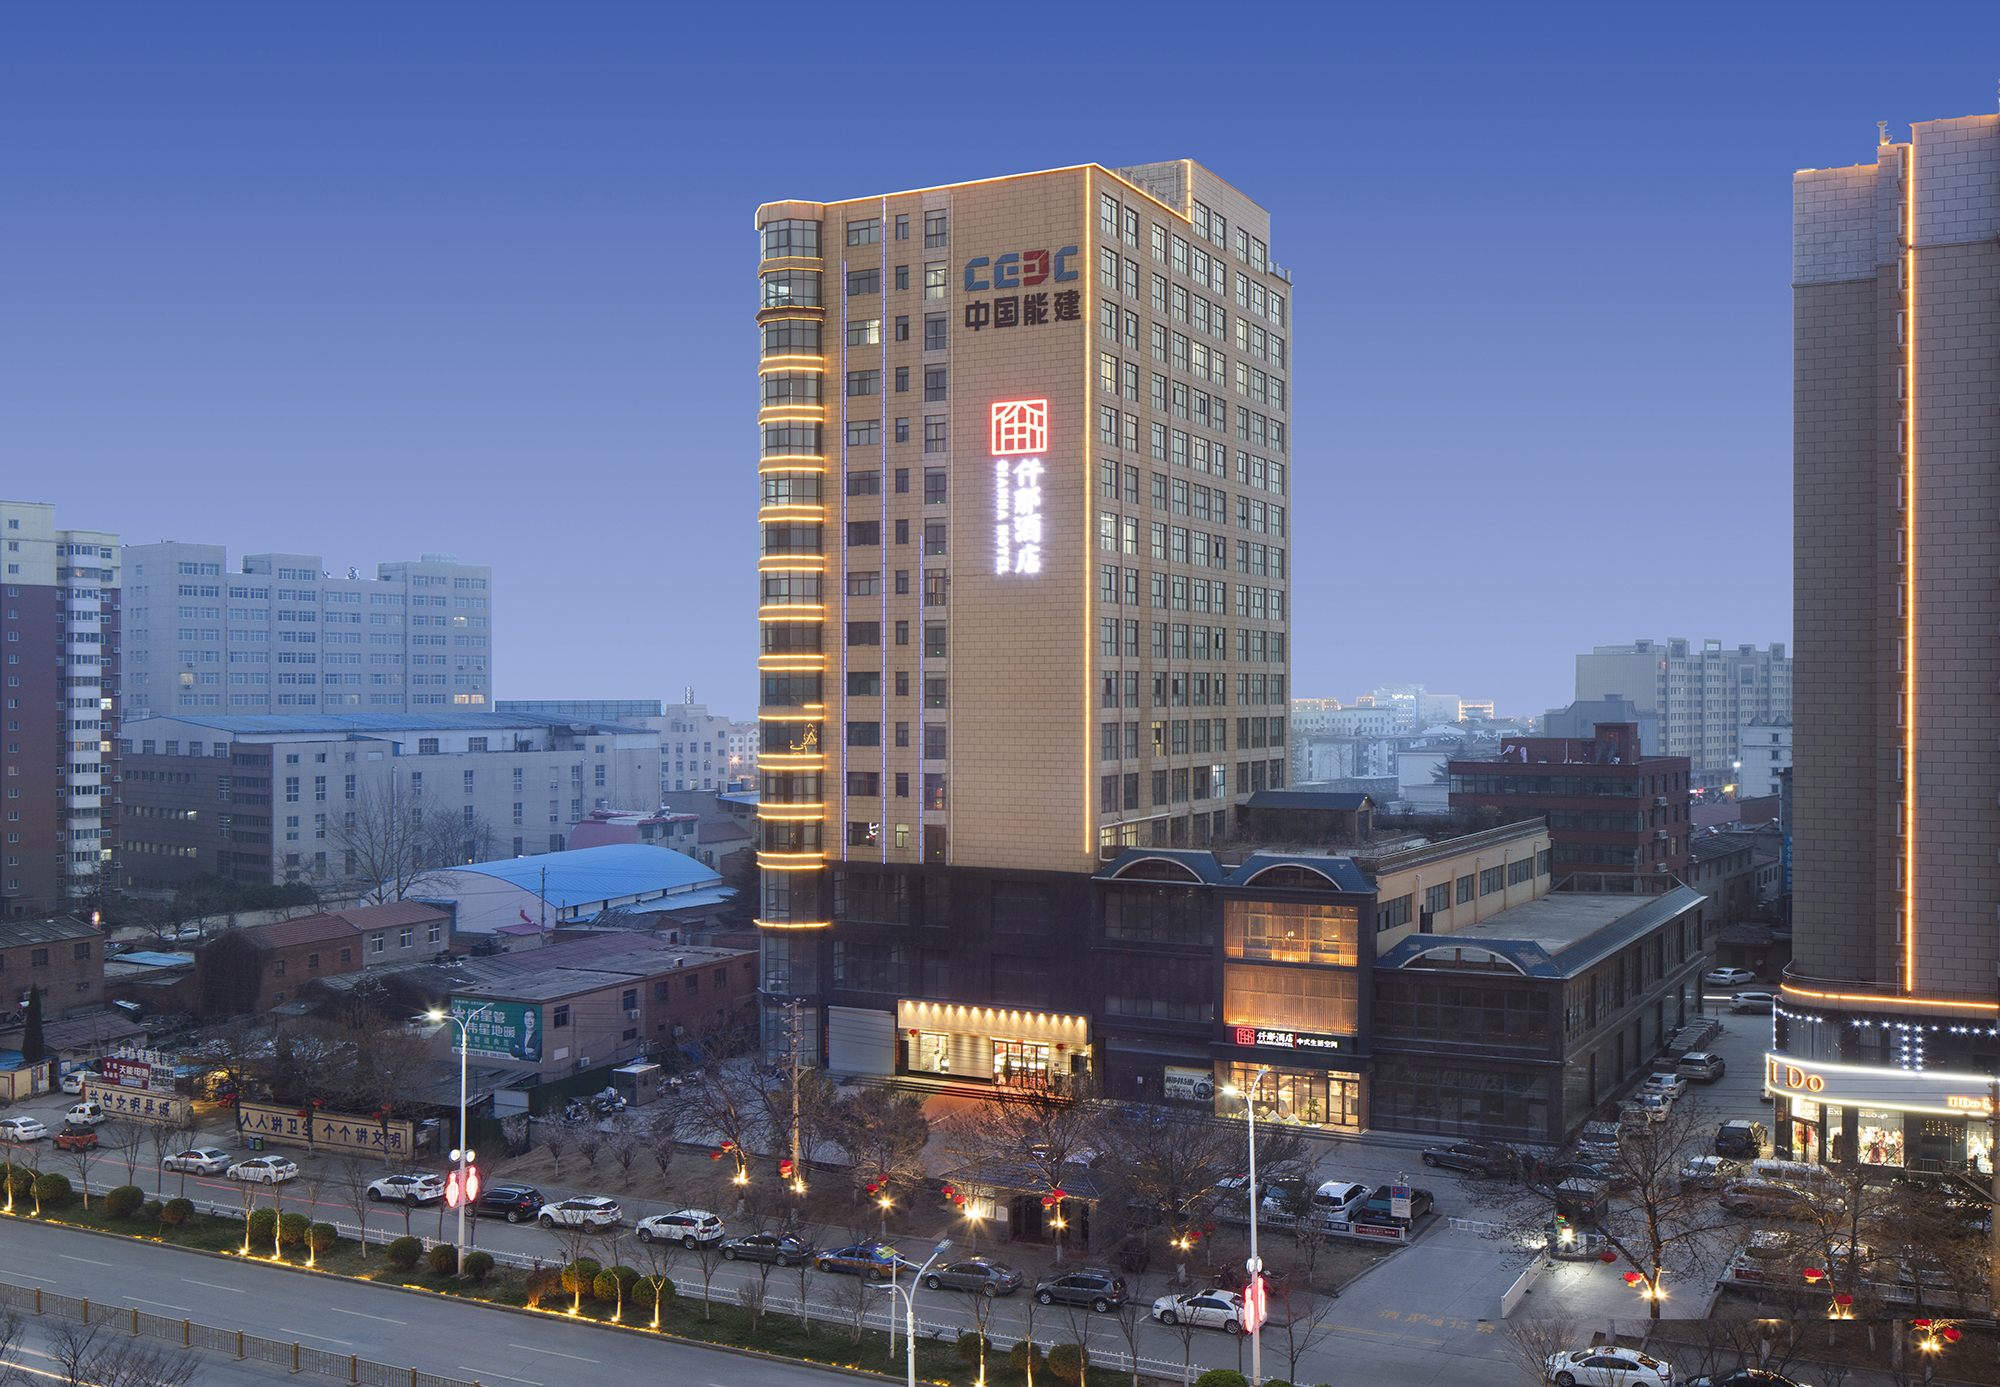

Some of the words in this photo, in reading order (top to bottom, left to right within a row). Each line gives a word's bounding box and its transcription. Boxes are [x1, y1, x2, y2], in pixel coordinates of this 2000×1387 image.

[965, 289, 1082, 331] 中国能建
[996, 459, 1010, 520] QIANNA
[1012, 458, 1045, 574] 仟那酒店
[996, 524, 1010, 575] HOTEL
[467, 1008, 506, 1024] 伟星管
[1297, 1038, 1339, 1049] 中式生活空间
[1770, 1060, 1779, 1084] I
[1785, 1064, 1825, 1093] Do
[323, 1122, 401, 1149] 个个讲文明
[1392, 1186, 1404, 1198] P
